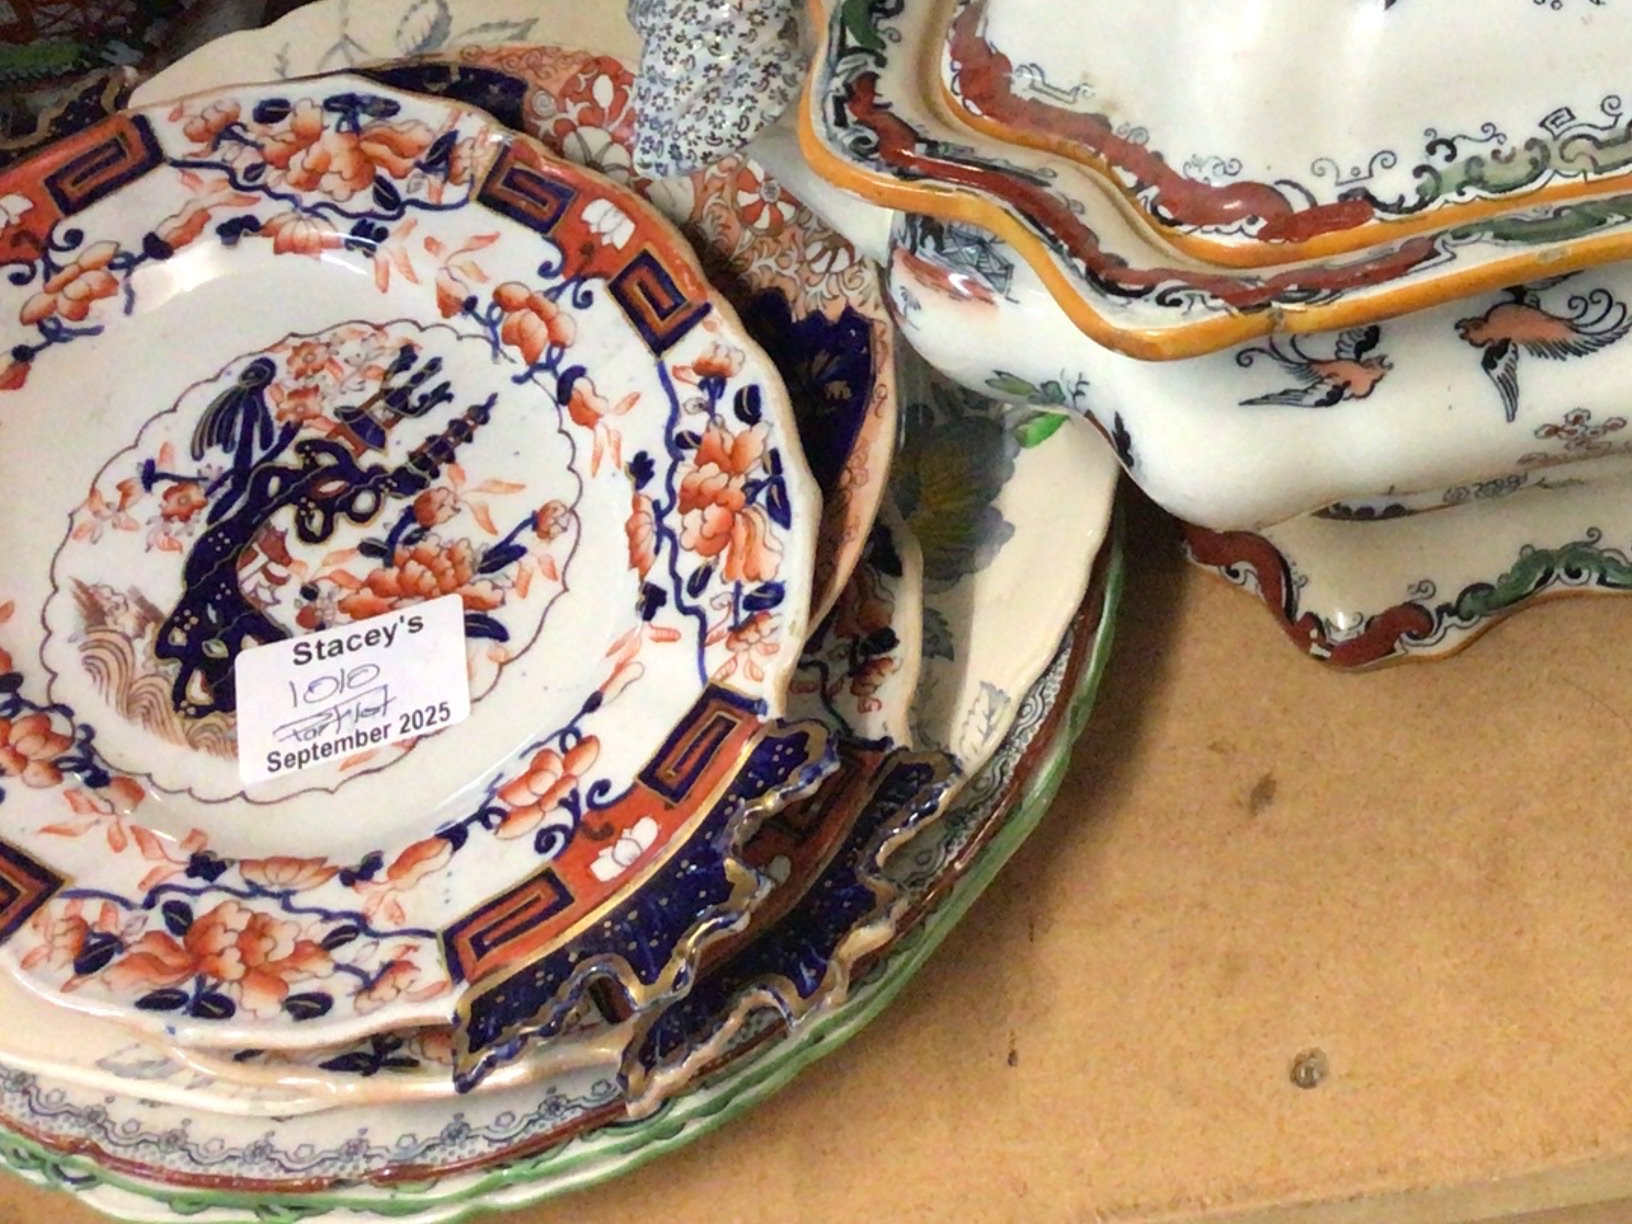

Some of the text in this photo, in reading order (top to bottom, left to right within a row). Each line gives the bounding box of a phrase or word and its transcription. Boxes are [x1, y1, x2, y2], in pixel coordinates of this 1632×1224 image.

[292, 614, 425, 666] Stacey's
[266, 701, 452, 774] September 2025
